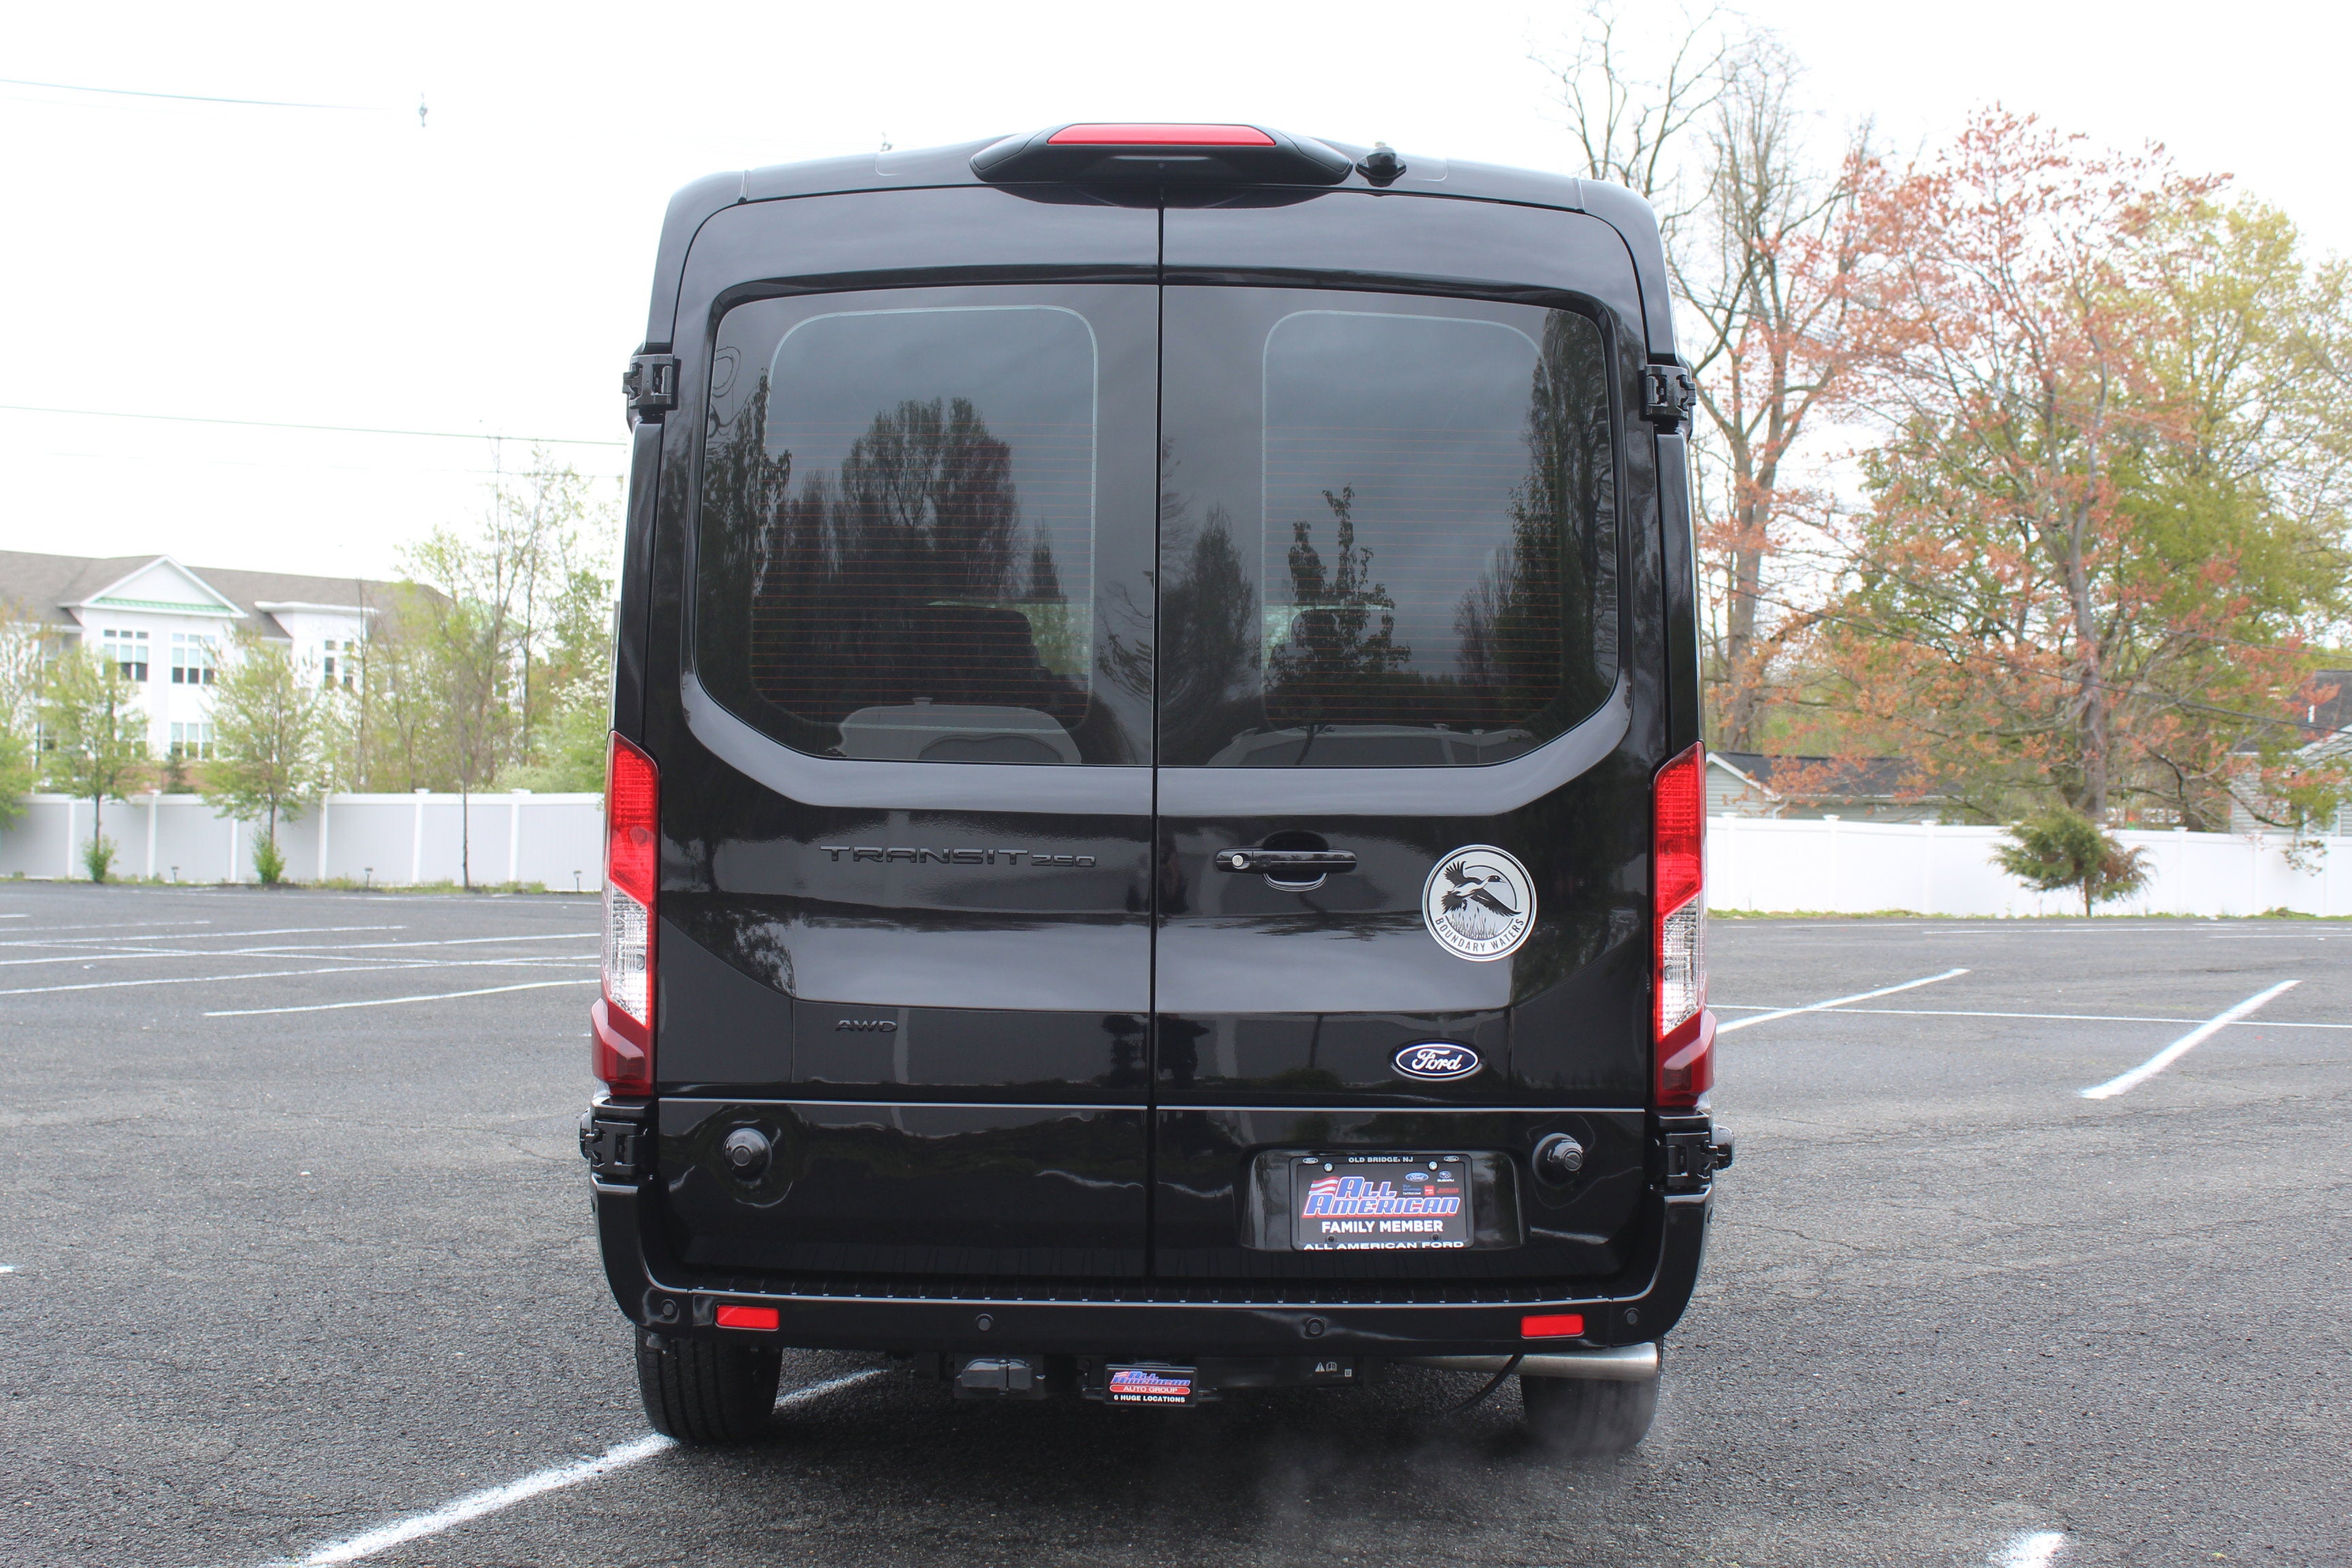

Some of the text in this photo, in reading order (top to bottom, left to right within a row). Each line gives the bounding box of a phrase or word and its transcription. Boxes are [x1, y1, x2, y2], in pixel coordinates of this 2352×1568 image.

[820, 845, 1096, 868] TRANSIT 250
[1435, 917, 1524, 952] BOUNDARY WATERS
[835, 1019, 898, 1032] AWD
[1411, 1049, 1463, 1071] Ford
[1322, 1220, 1443, 1233] FAMILY MEMBER
